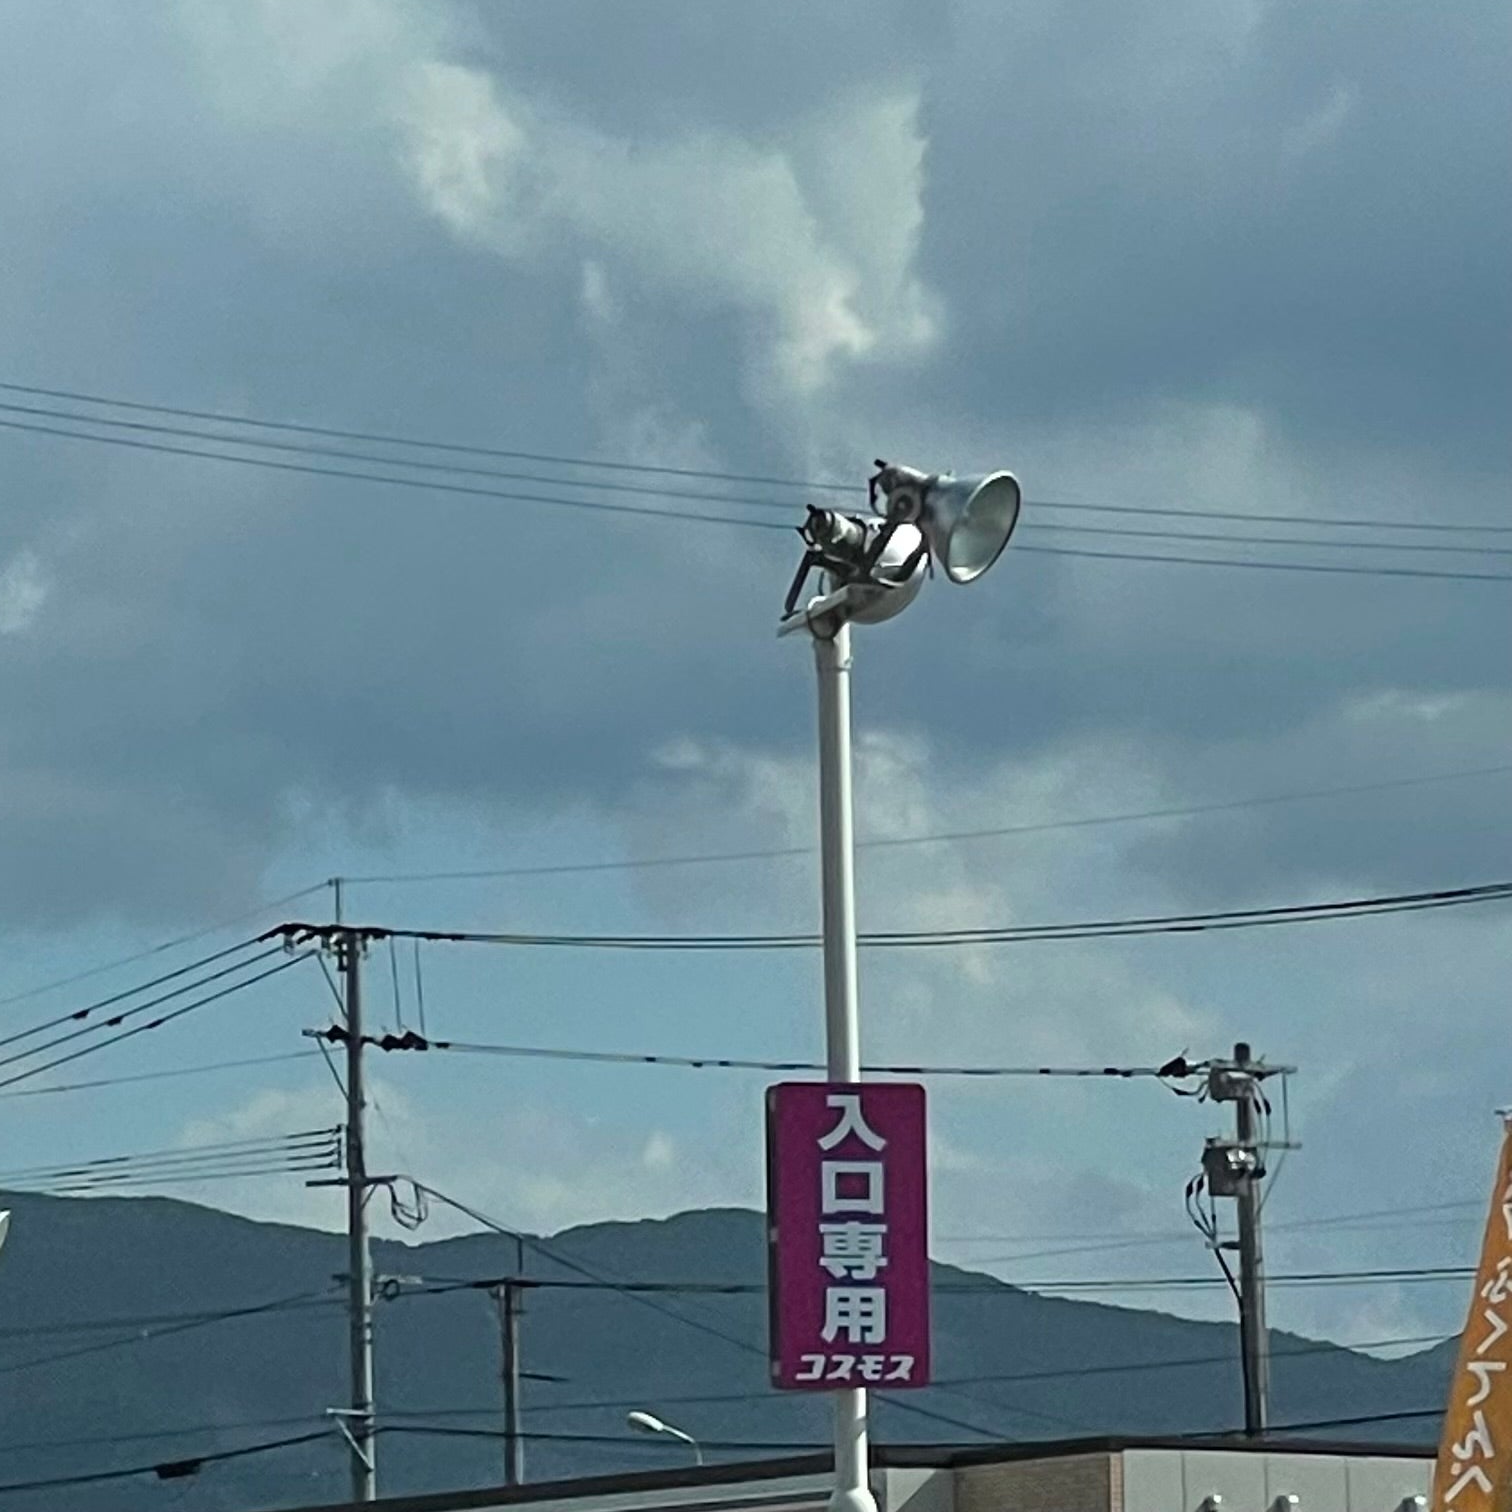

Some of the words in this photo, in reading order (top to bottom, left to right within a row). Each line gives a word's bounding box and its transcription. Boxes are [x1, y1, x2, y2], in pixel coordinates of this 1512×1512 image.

[817, 1094, 887, 1344] 入口専用
[795, 1354, 915, 1381] コスモス
